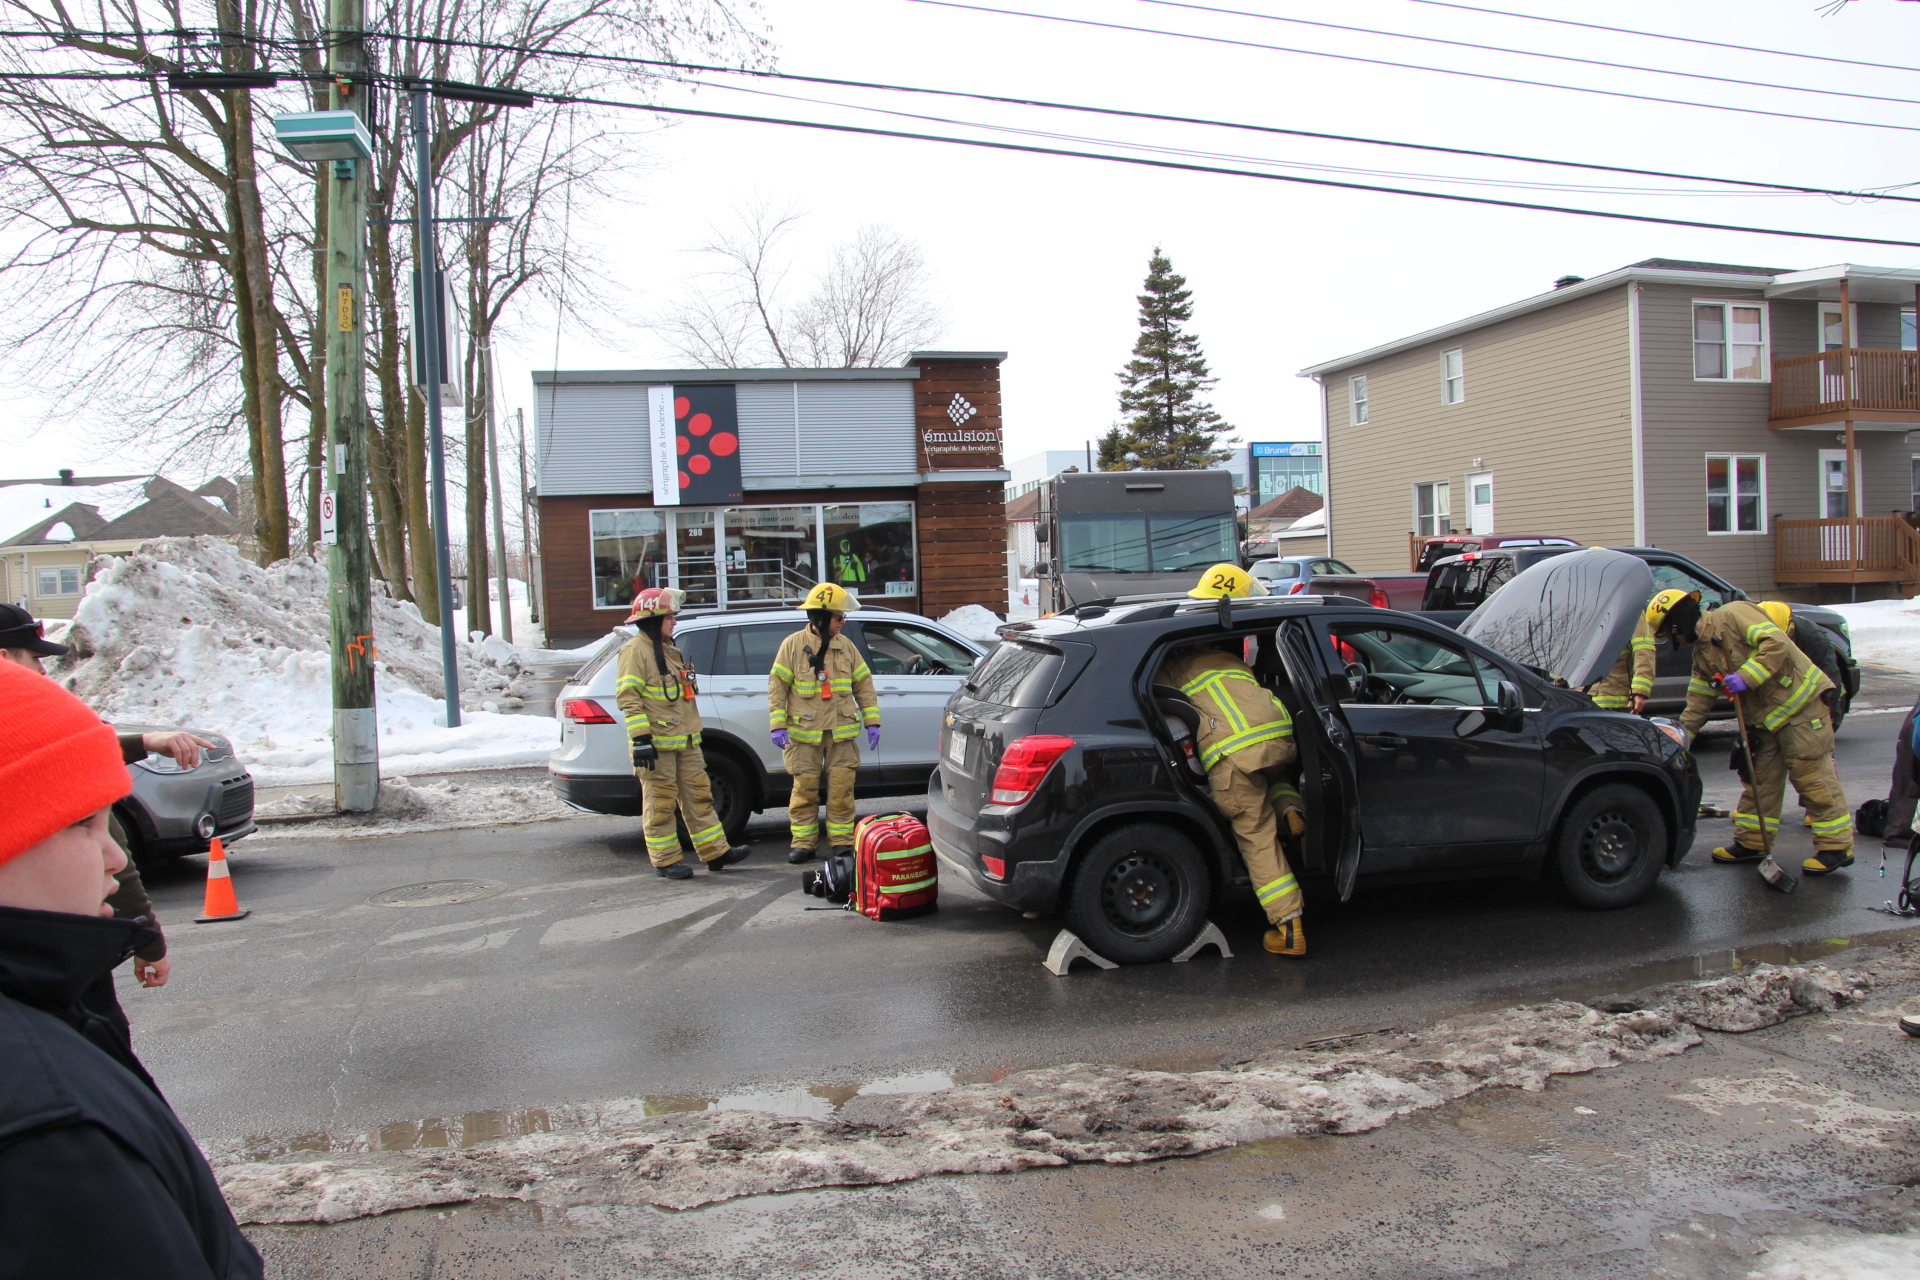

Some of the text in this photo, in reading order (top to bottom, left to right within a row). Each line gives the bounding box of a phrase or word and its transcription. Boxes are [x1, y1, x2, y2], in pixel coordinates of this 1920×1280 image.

[924, 429, 996, 443] émulsion
[1264, 446, 1289, 454] Brunet
[1212, 574, 1235, 592] 24
[638, 597, 659, 611] 141
[816, 591, 834, 603] 41
[1652, 594, 1670, 613] 26
[892, 870, 929, 880] PARAMEDIC
